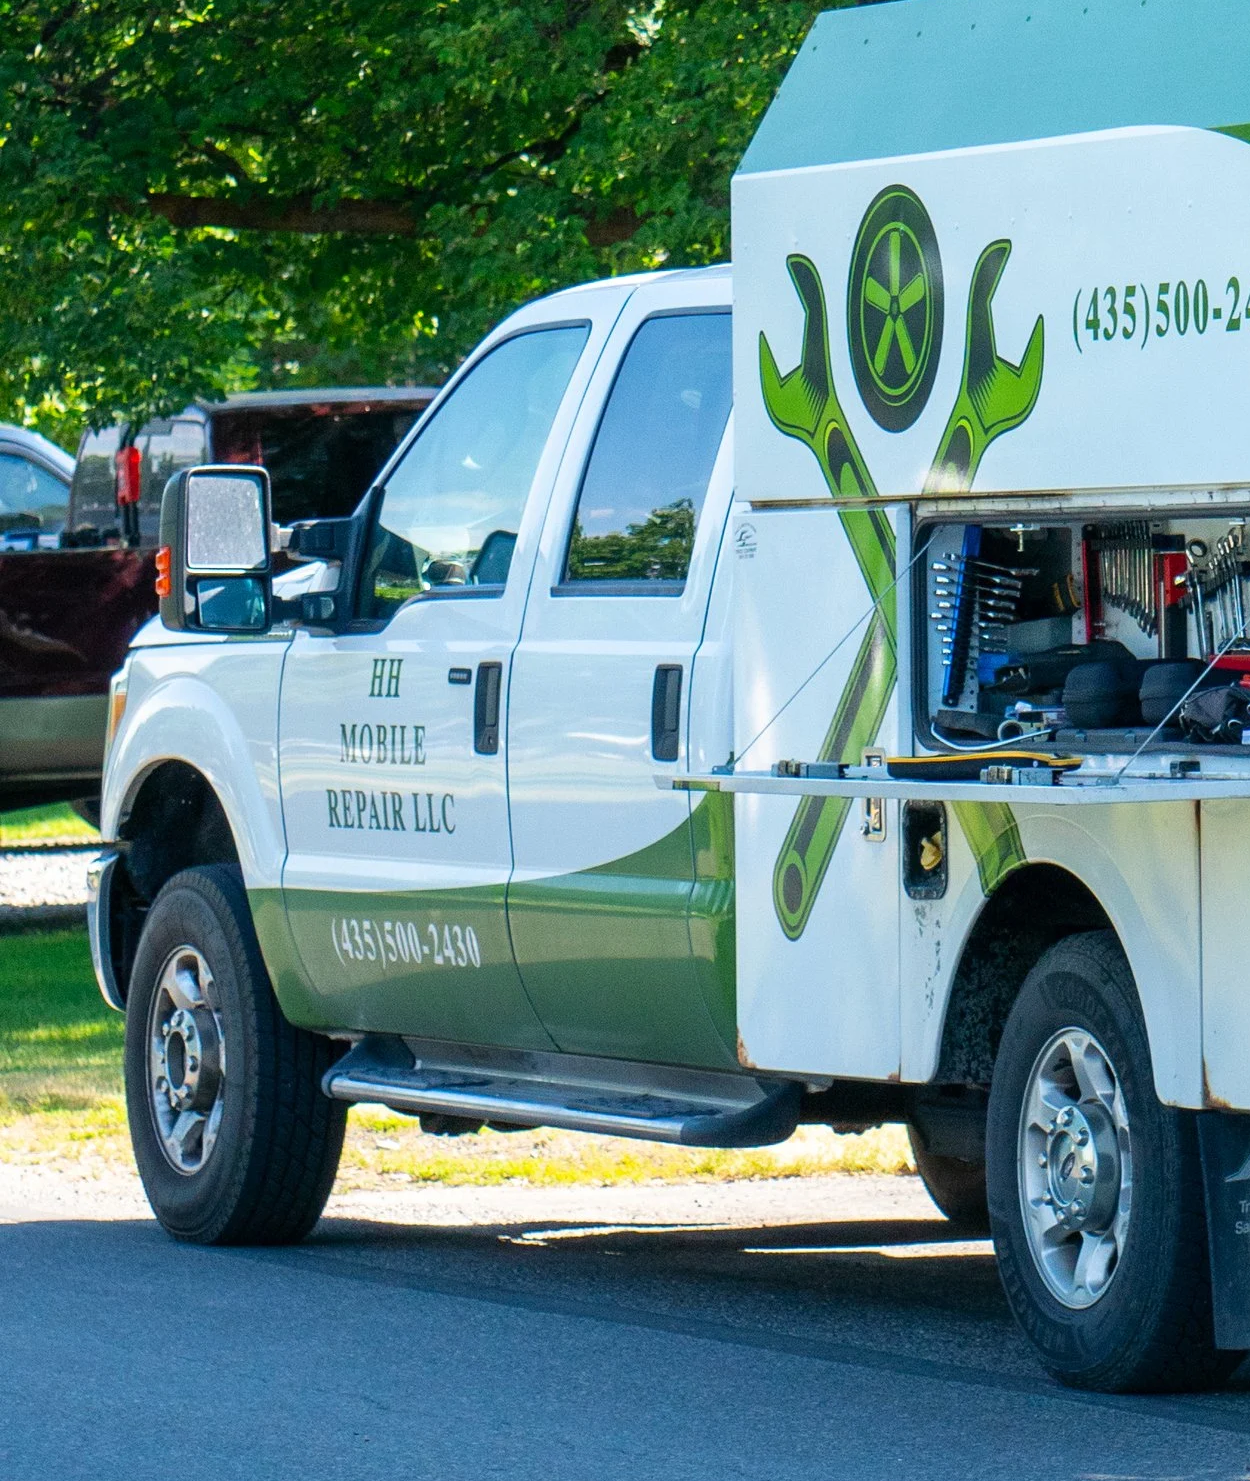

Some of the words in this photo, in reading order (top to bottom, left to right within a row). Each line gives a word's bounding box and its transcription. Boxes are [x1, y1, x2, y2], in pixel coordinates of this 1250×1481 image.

[368, 659, 404, 698] HH
[340, 723, 427, 765] MOBILE
[326, 788, 406, 831] REPAIR
[411, 792, 457, 834] LLC
[331, 918, 481, 968] (435)500-2430
